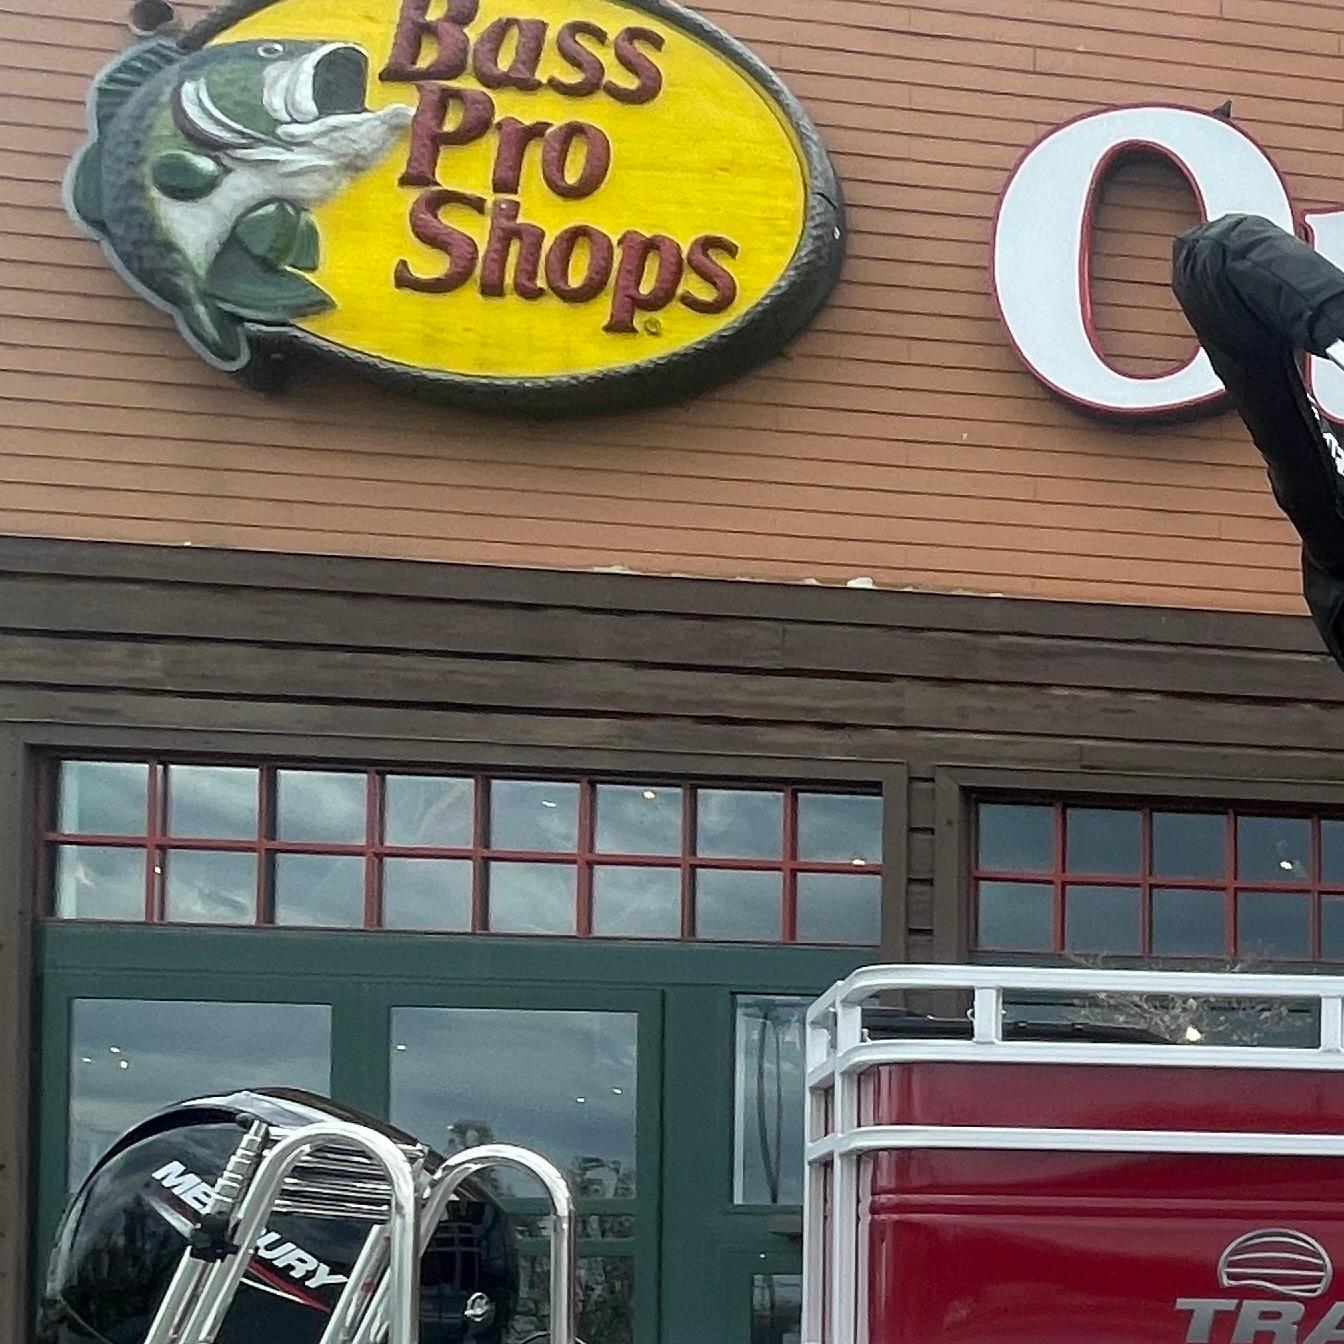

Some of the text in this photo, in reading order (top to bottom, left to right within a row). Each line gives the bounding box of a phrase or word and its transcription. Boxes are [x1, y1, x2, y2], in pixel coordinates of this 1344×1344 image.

[379, 0, 665, 105] Bass
[398, 81, 611, 199] Pro
[394, 188, 739, 334] Shops
[150, 1159, 348, 1291] MEURY
